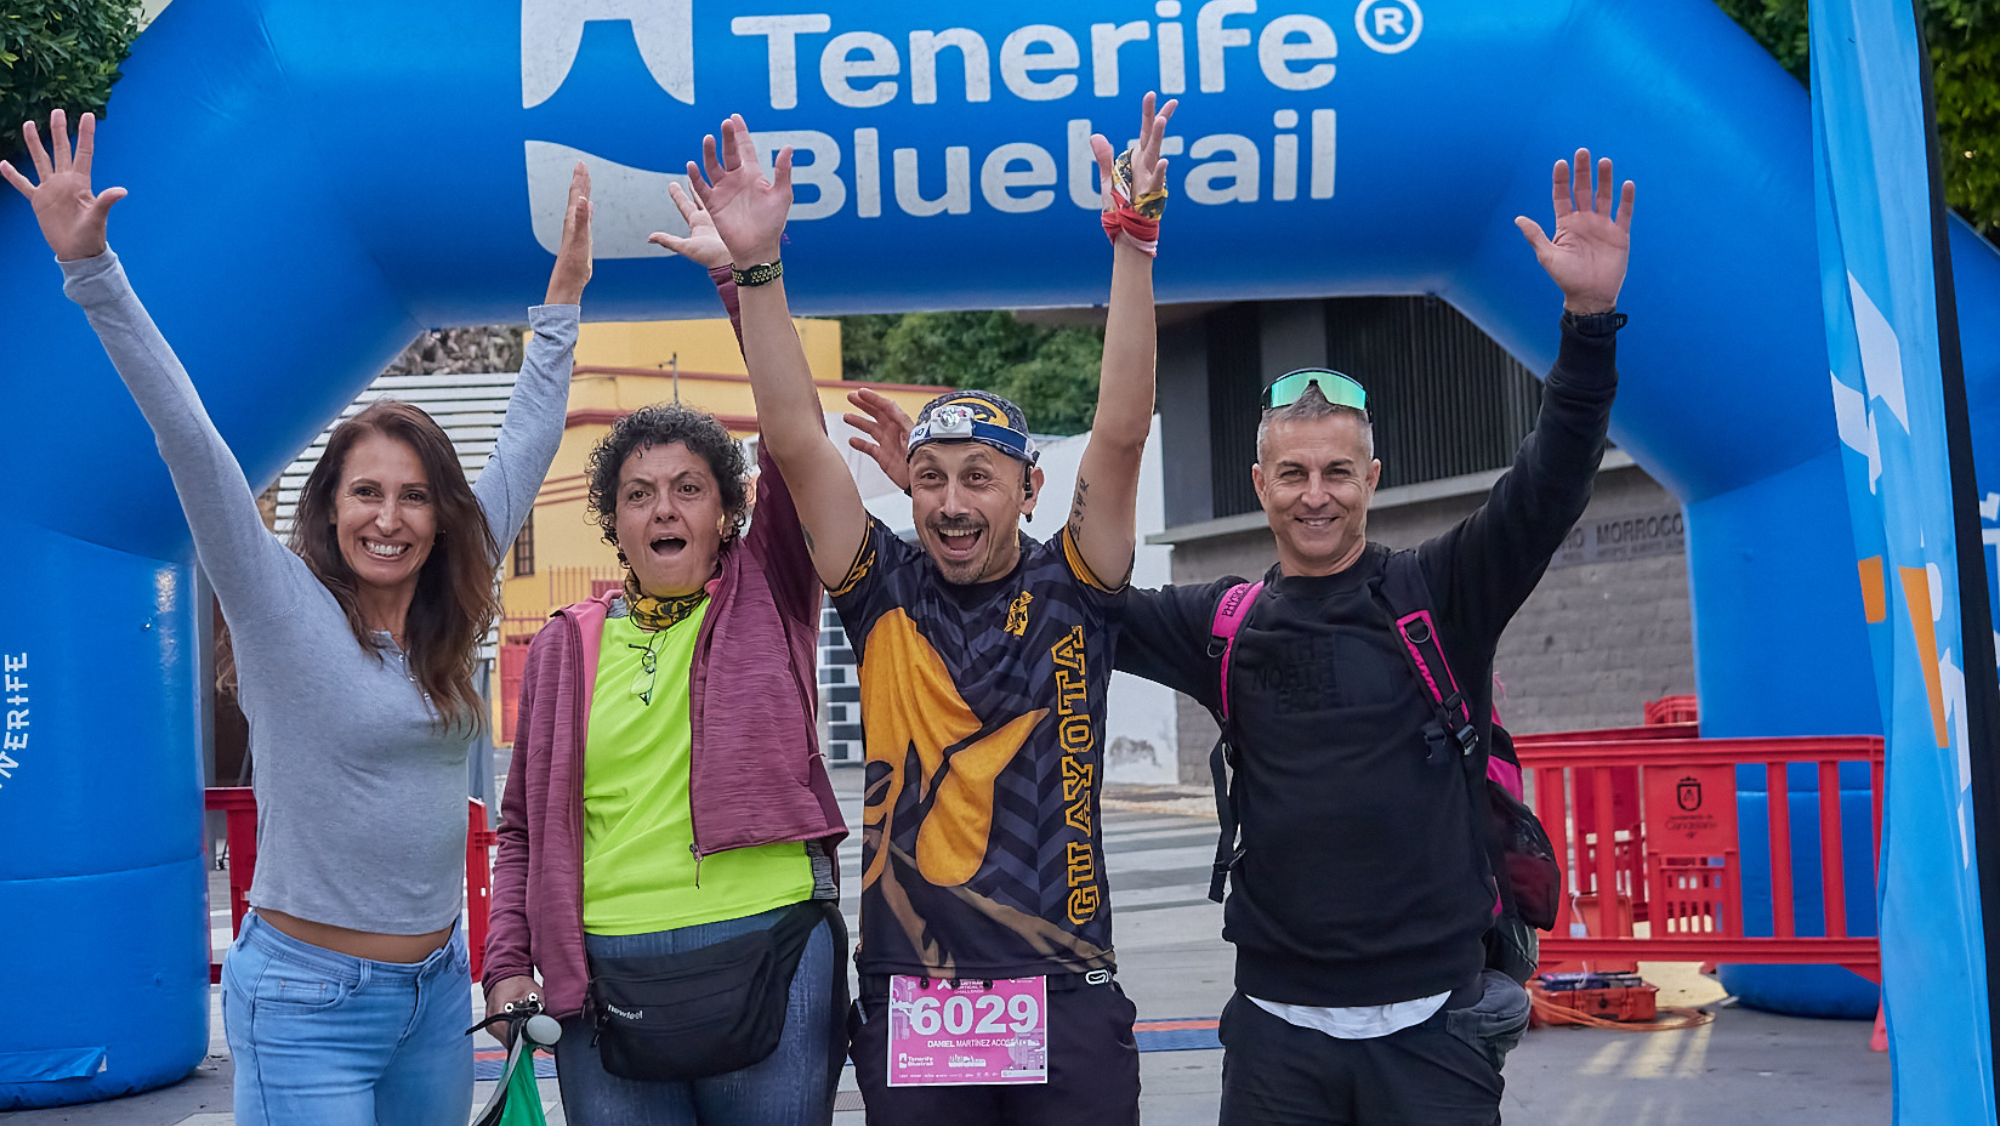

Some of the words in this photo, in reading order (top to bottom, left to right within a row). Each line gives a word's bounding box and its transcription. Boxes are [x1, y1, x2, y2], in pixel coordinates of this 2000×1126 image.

[731, 0, 1338, 109] Tenerife
[0, 652, 30, 788] NERIFE
[1051, 625, 1100, 925] GUAYOTA
[911, 994, 1039, 1035] 6029
[927, 1040, 956, 1048] DANIEL
